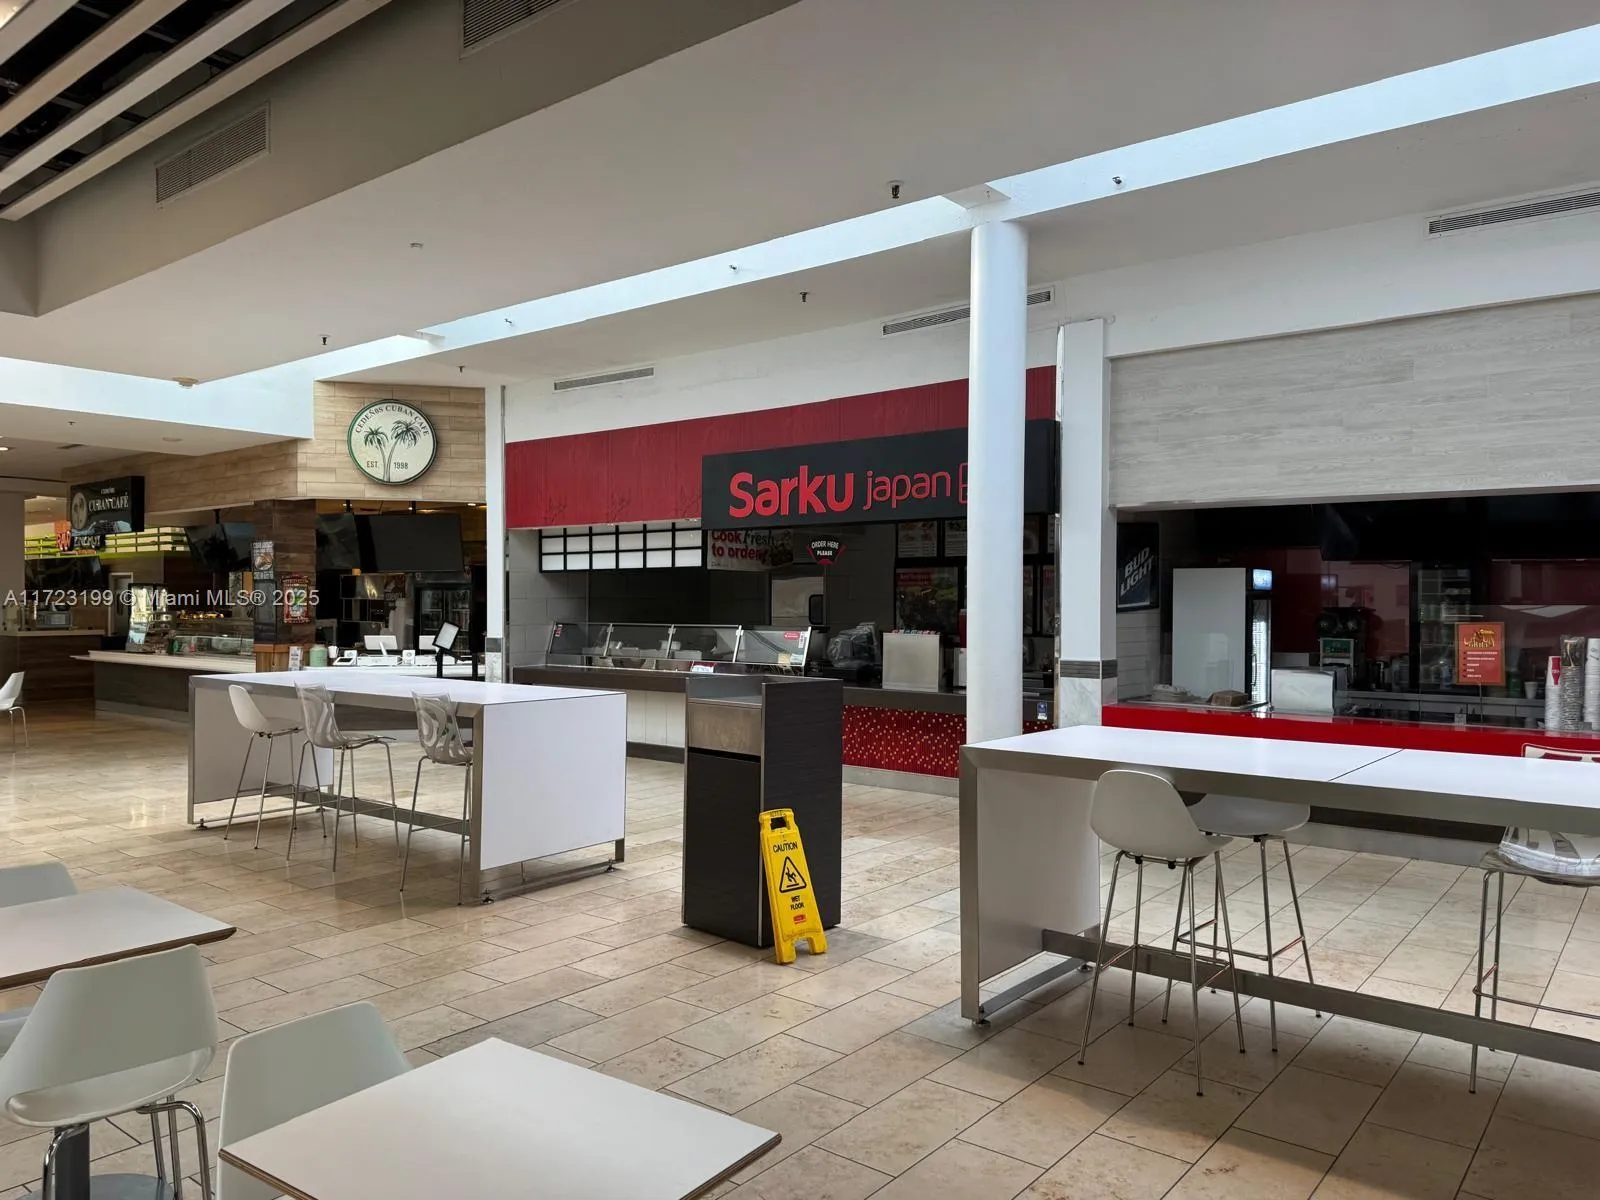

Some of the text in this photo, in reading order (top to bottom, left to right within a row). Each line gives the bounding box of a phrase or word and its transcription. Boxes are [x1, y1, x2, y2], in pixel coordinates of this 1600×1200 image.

[385, 404, 415, 417] CUBAN
[393, 461, 409, 470] 1998
[729, 465, 951, 517] Sarku japan
[711, 543, 725, 558] to
[811, 540, 840, 549] ORDER HERE
[816, 549, 833, 557] PLEASE
[1124, 547, 1151, 579] BUD
[1121, 555, 1153, 596] LIGHT
[772, 842, 798, 853] CAUTION
[790, 902, 804, 910] FLOOR
